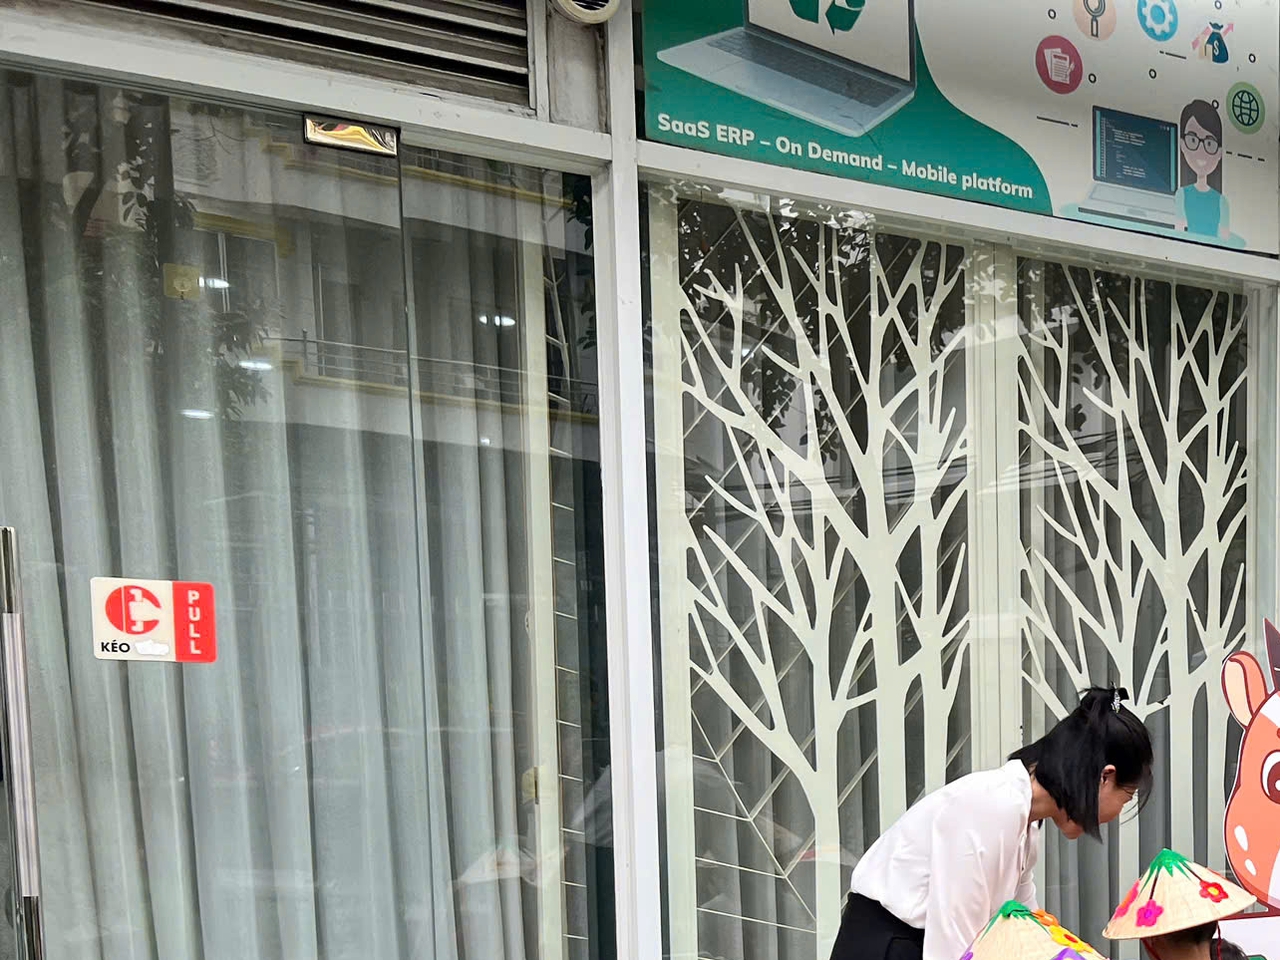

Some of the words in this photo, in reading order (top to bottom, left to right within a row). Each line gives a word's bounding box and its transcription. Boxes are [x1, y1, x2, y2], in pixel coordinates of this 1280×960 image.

[657, 113, 710, 139] SaaS
[716, 124, 755, 146] ERP
[775, 136, 802, 156] On
[808, 142, 883, 171] Demand
[902, 159, 958, 185] Mobile
[961, 173, 1033, 199] platform
[101, 639, 130, 653] KÉO
[187, 589, 202, 655] PULL
